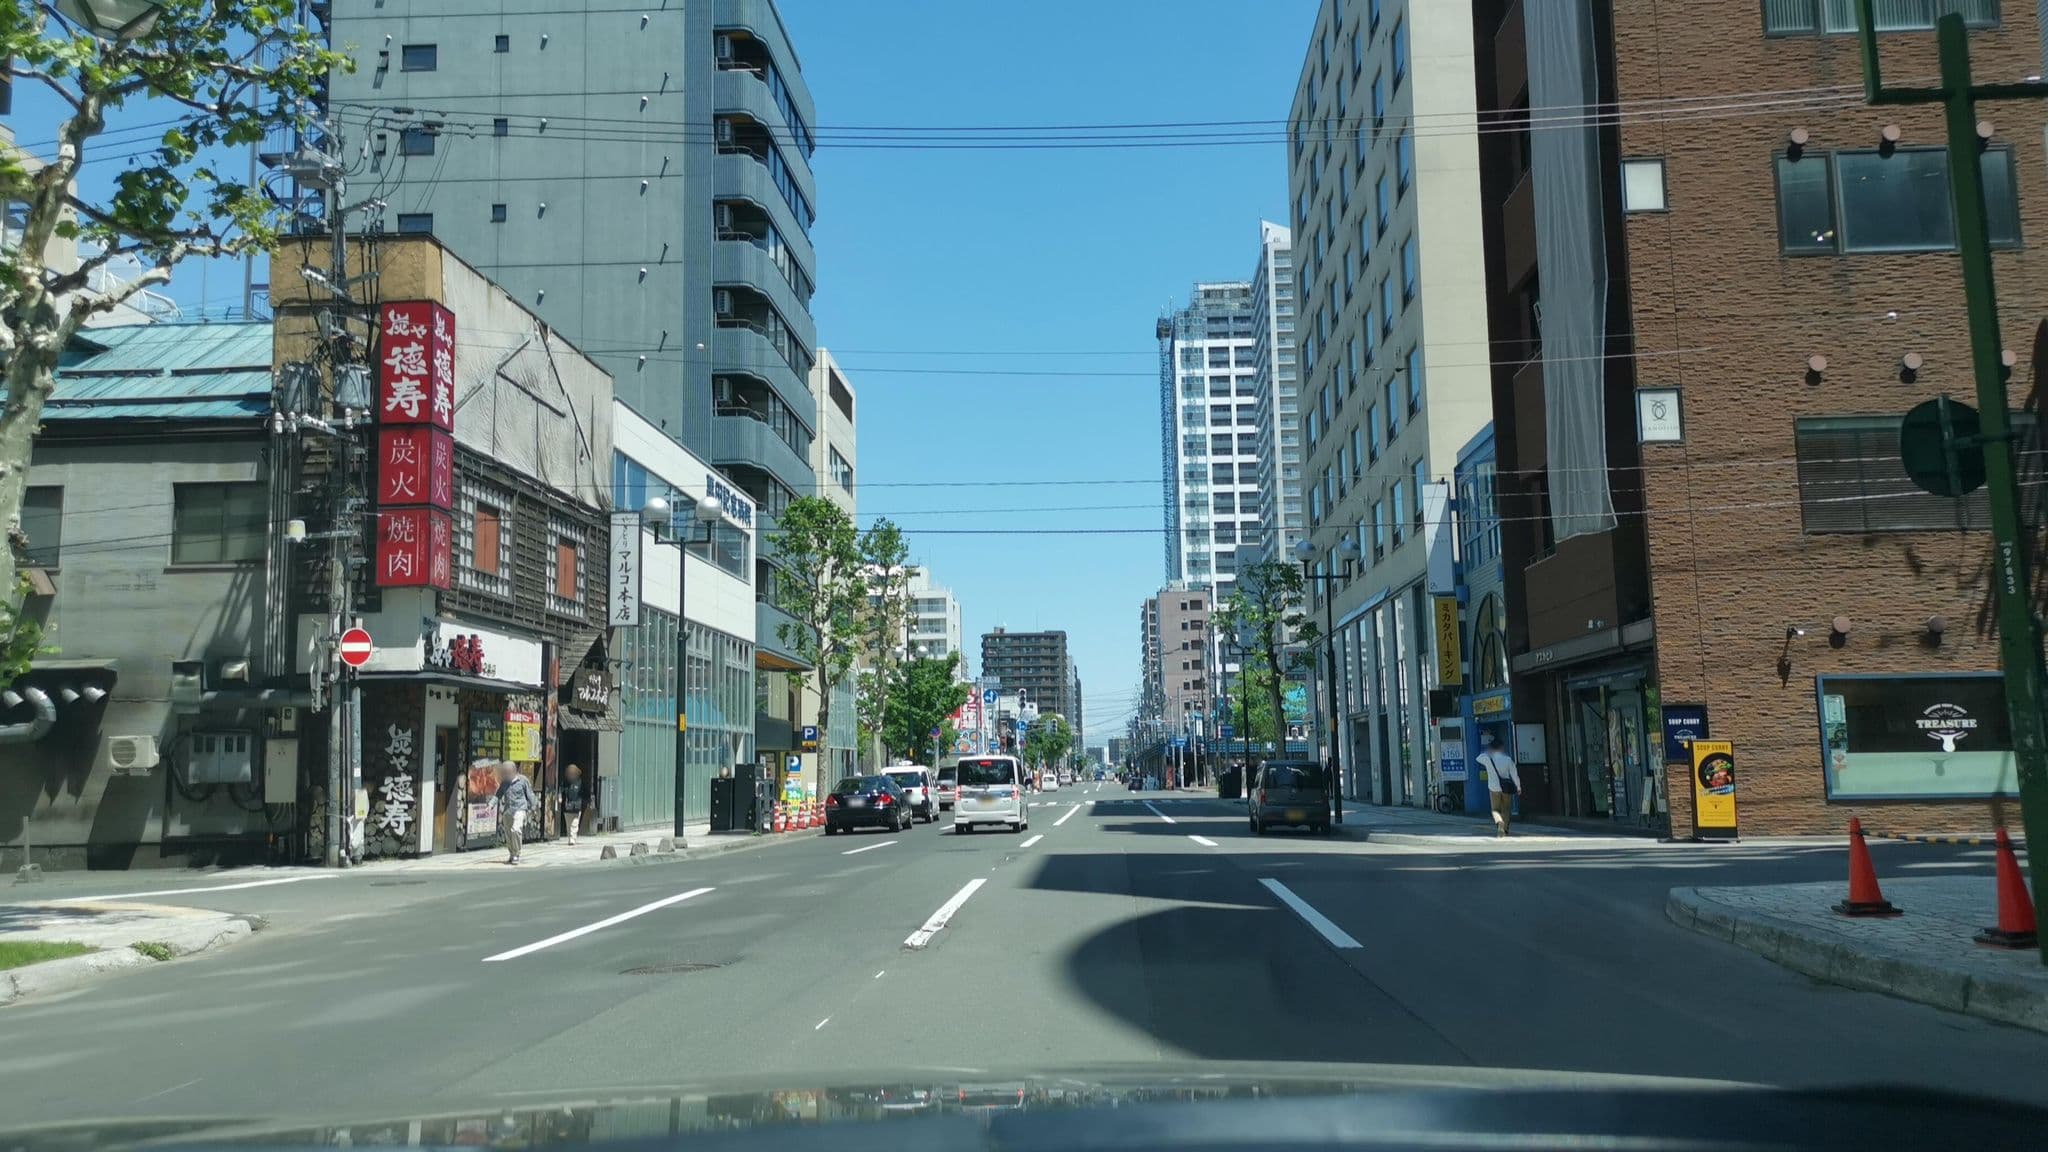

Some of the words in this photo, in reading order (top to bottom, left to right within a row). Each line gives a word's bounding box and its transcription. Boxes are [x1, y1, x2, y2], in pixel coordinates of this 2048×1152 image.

[390, 437, 416, 499] 炭火
[435, 441, 447, 503] 炭火
[387, 516, 415, 578] 焼肉
[615, 550, 634, 621] マルコ本店
[1440, 602, 1455, 680] ミカタパーキング
[804, 727, 814, 740] P
[1668, 718, 1682, 726] SOUP
[1683, 718, 1700, 726] CURRY
[1697, 744, 1710, 752] SOUP
[1915, 719, 1977, 729] TREASURE
[379, 723, 415, 837] 炭や徳寿
